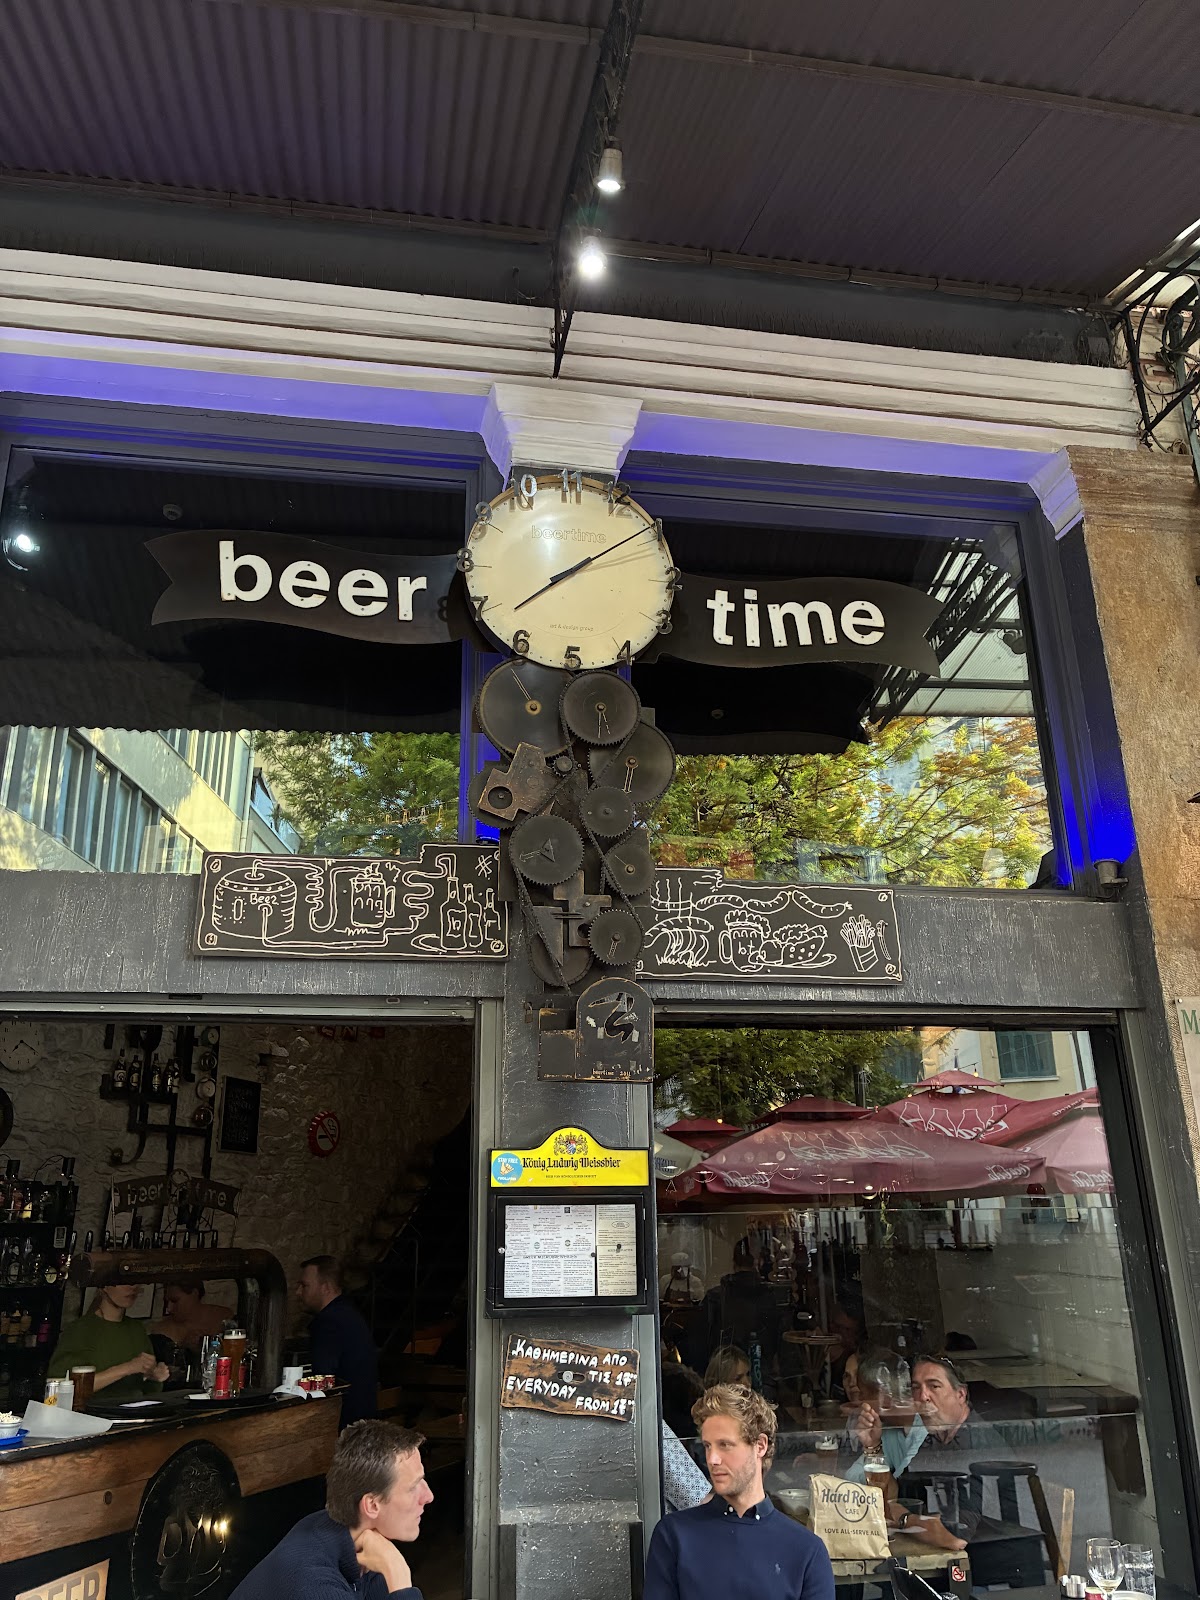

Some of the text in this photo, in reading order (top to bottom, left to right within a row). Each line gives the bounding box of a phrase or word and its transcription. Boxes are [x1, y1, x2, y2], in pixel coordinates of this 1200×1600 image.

[511, 473, 537, 497] 10
[559, 468, 582, 493] 11
[606, 481, 631, 505] 12
[475, 501, 493, 525] 9
[531, 525, 606, 543] beertime
[456, 547, 474, 572] 8
[665, 566, 683, 590] 2
[218, 540, 885, 647] beer time
[470, 595, 489, 621] 7
[656, 609, 673, 634] 3
[513, 629, 530, 654] 6
[617, 640, 633, 666] 4
[564, 645, 581, 669] 5
[522, 1157, 545, 1171] König
[545, 1157, 578, 1171] Ludwig
[506, 1375, 577, 1399] EVERYDAY
[575, 1397, 609, 1412] FROM
[821, 1488, 878, 1509] Hard Rock
